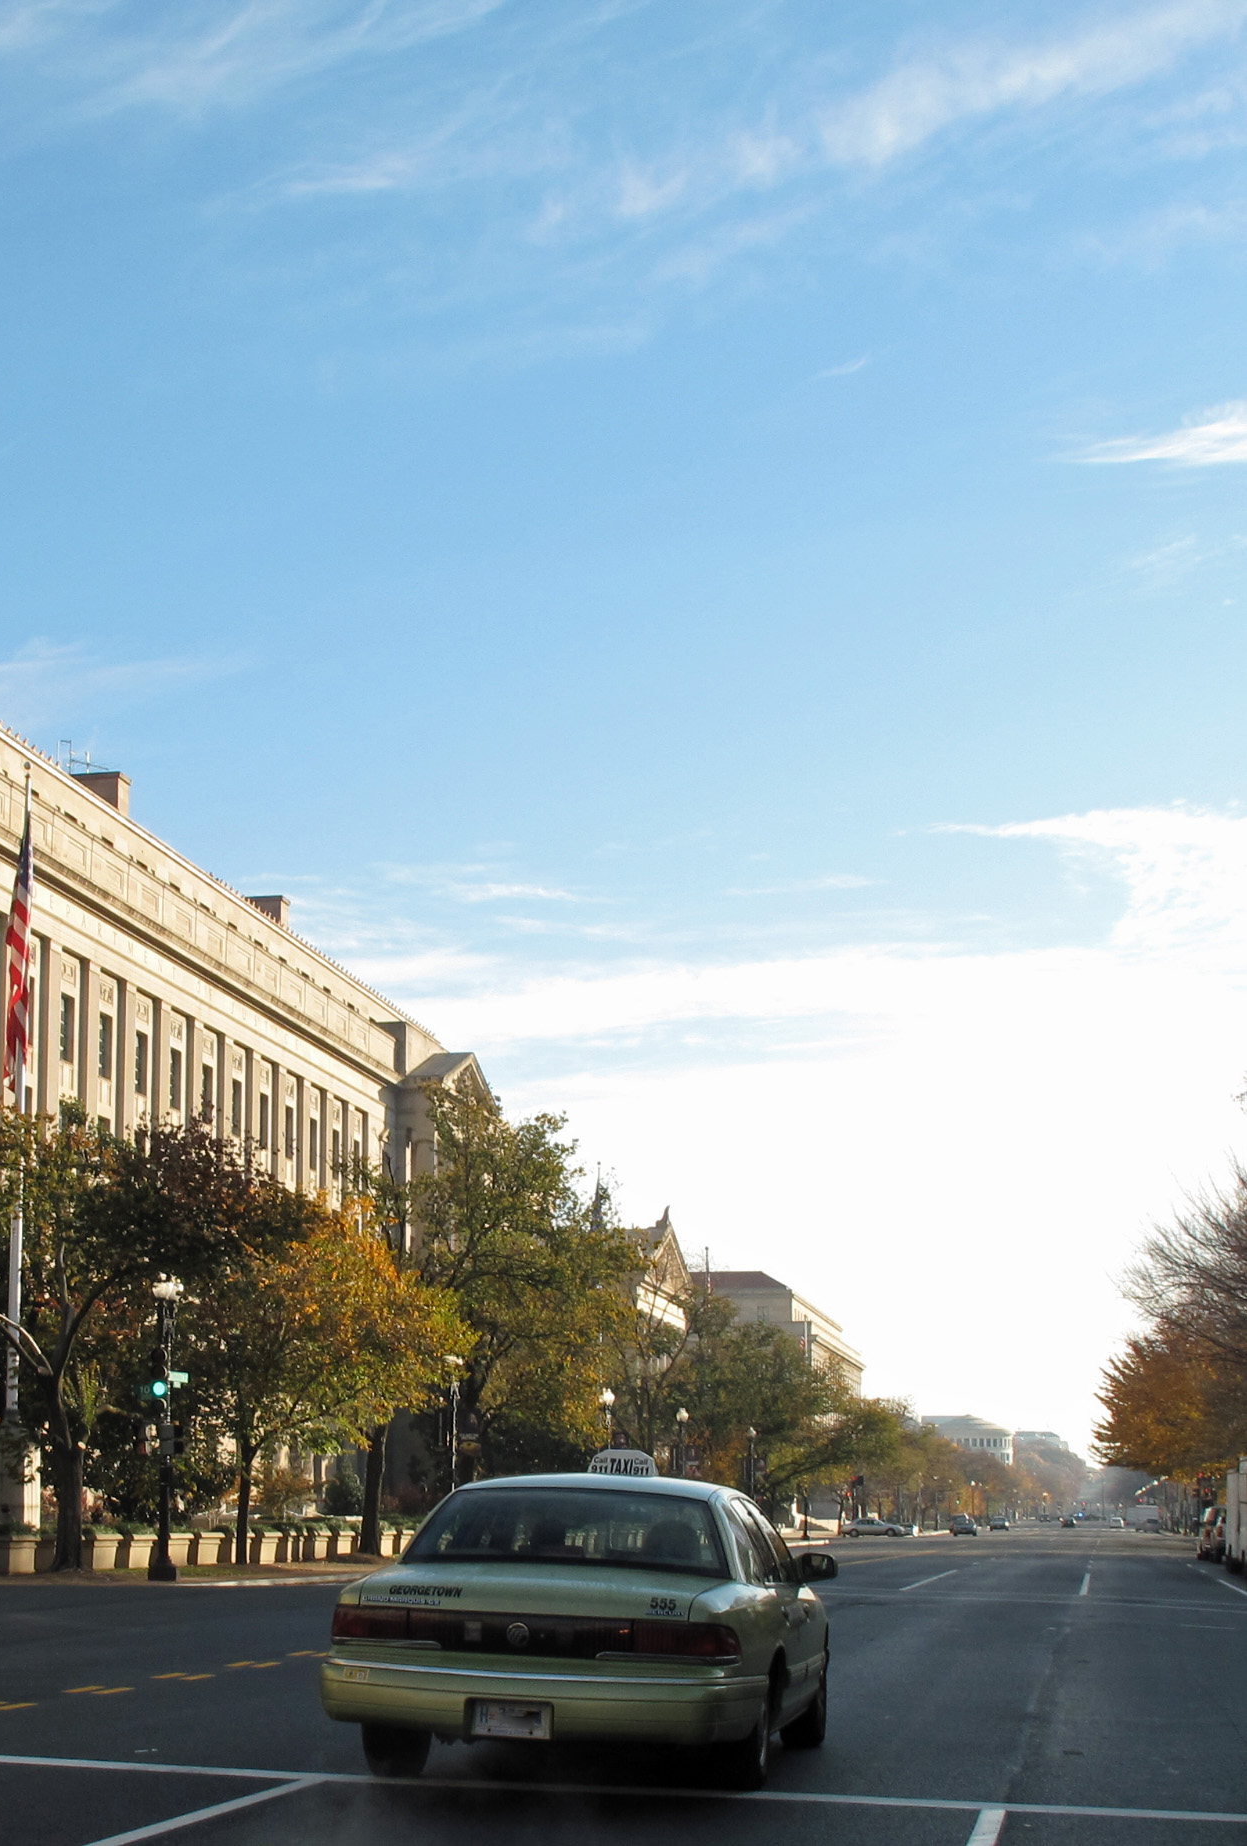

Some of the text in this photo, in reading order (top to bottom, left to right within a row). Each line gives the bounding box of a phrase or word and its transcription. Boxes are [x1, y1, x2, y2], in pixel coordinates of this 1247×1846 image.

[32, 884, 178, 981] DEPARTMENT
[230, 1000, 301, 1052] JUSTICE
[591, 1464, 649, 1475] 911 911
[594, 1456, 649, 1475] Call TAXI Call
[389, 1585, 463, 1598] GEORGETOWN
[650, 1597, 677, 1611] 555
